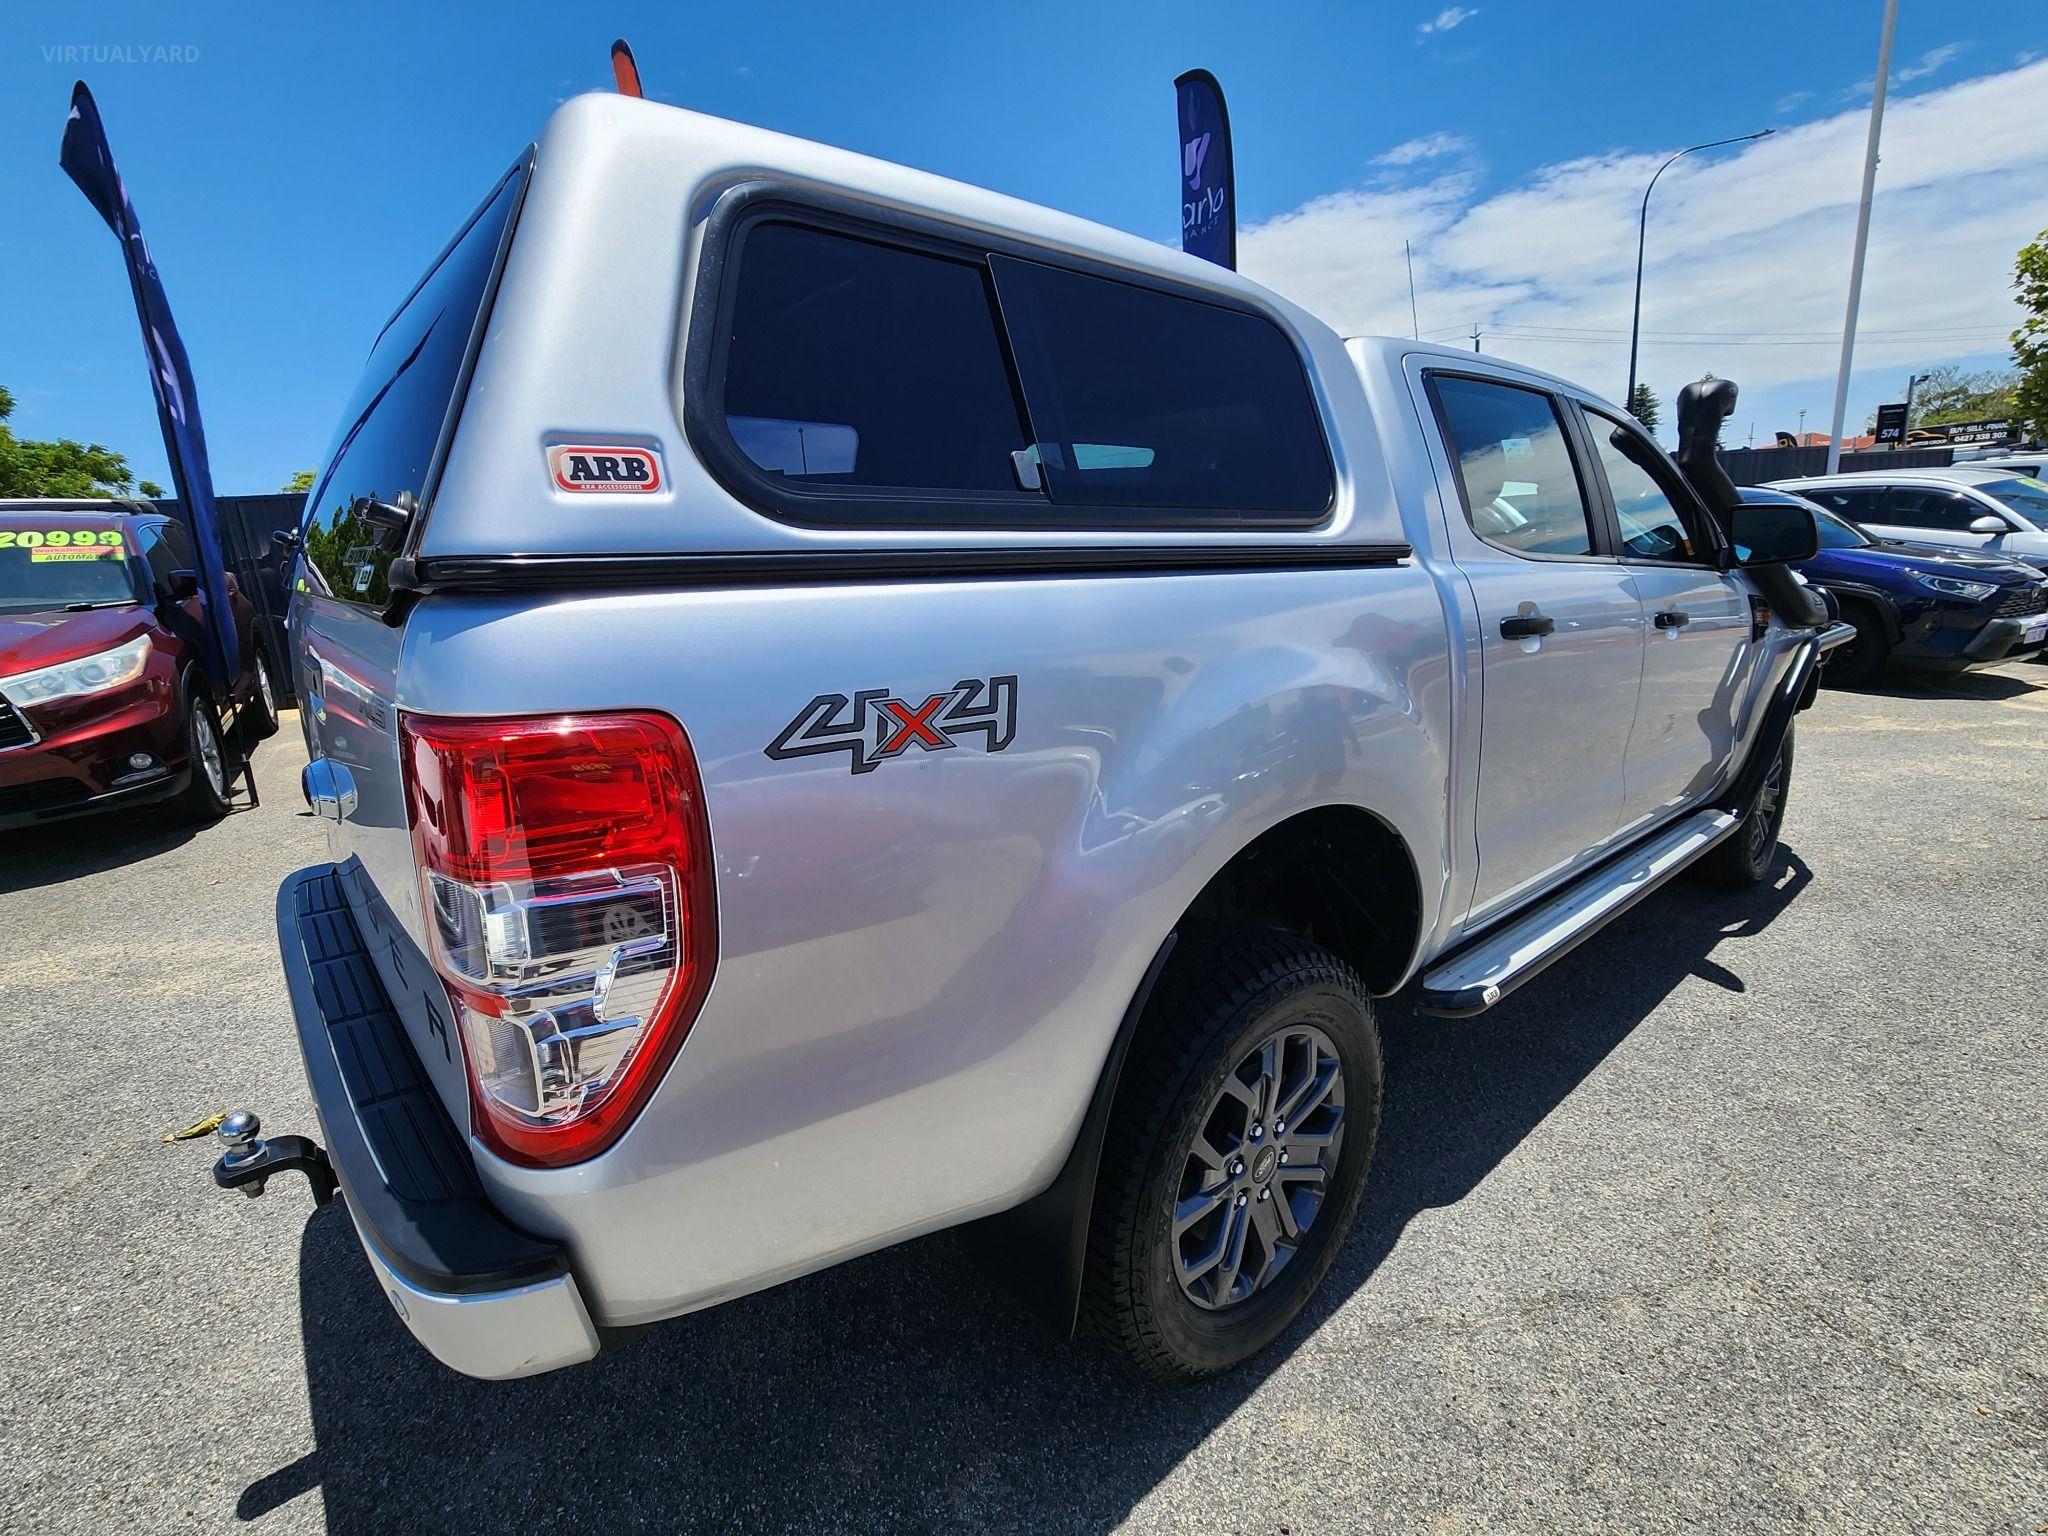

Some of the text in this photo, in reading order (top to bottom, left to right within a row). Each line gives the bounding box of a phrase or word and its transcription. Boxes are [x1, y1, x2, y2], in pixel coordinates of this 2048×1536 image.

[1967, 424, 1983, 432] SELL
[1880, 428, 1900, 439] 574
[1992, 431, 2008, 439] 302
[568, 456, 650, 481] ARB
